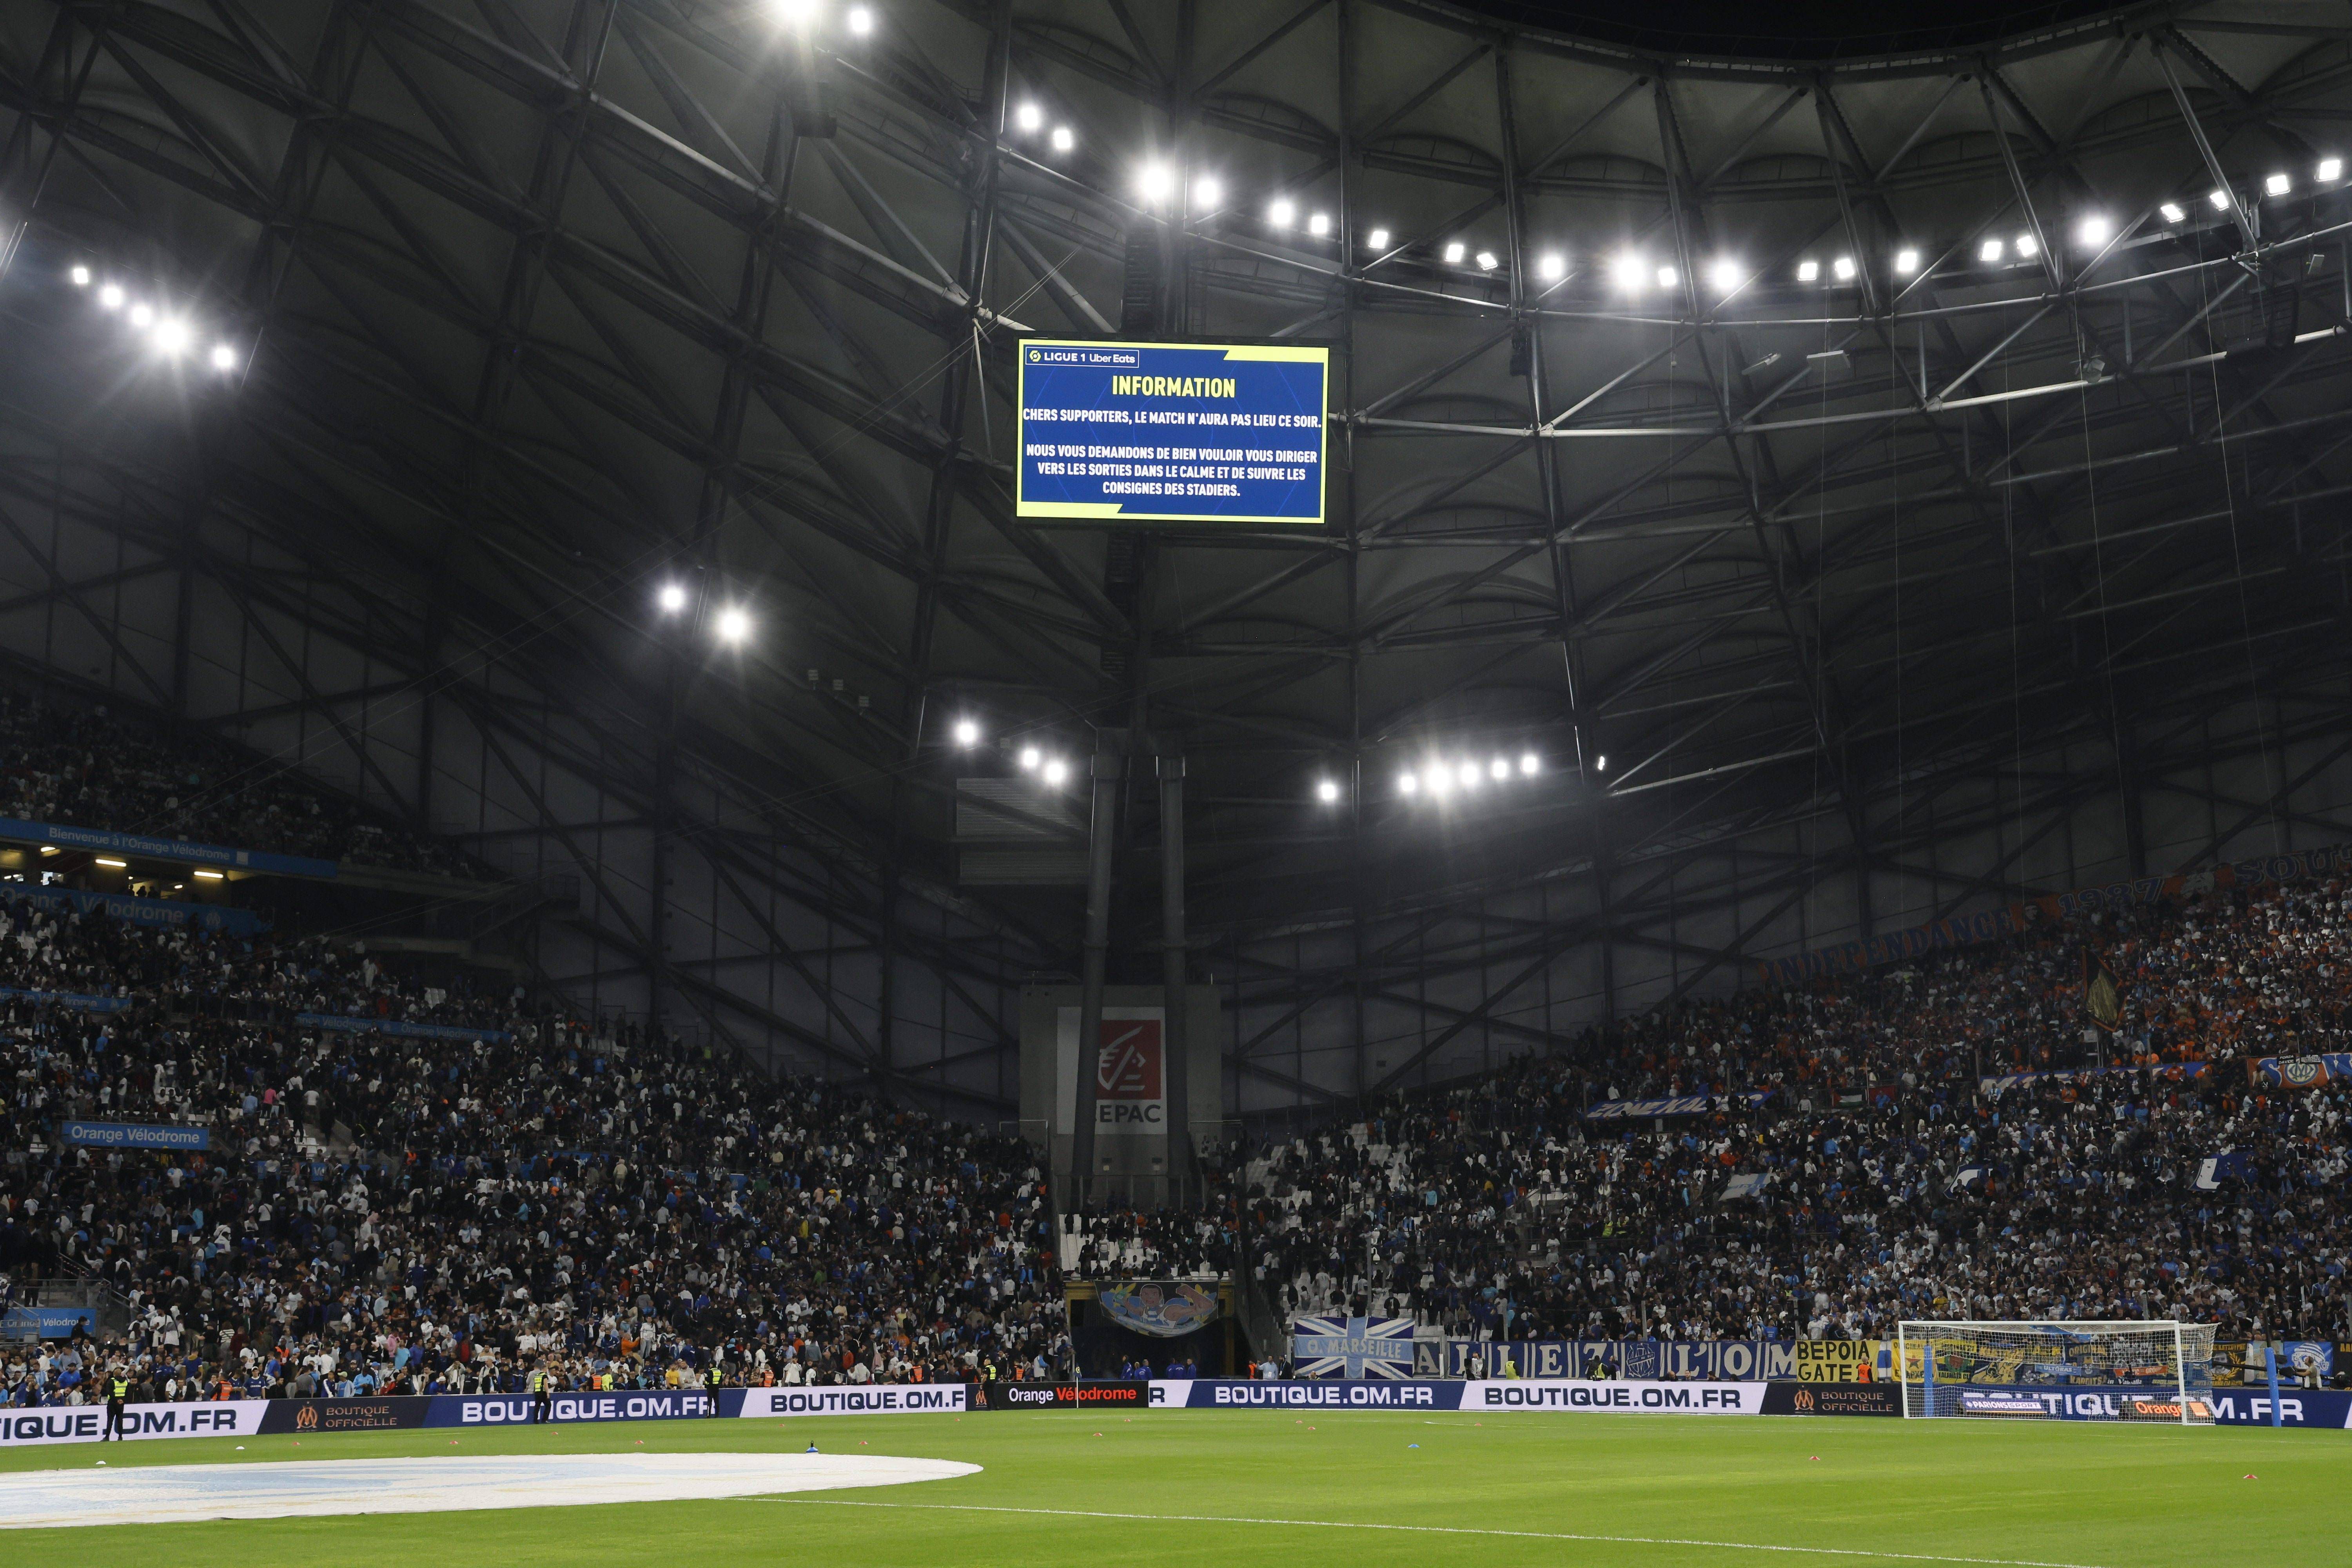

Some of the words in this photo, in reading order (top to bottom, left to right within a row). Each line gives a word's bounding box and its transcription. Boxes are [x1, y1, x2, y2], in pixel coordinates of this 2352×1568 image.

[1044, 352, 1078, 361] LIGUE
[1080, 353, 1085, 362] 1
[1089, 353, 1111, 363] Uber
[1113, 354, 1135, 363] Eats
[1112, 375, 1235, 398] INFORMATION
[1023, 408, 1058, 421] CHERS
[1060, 410, 1132, 425] SUPPORTERS,
[1135, 412, 1147, 423] LE
[1149, 412, 1185, 424] MATCH
[1187, 413, 1228, 425] N'AURA
[1231, 414, 1251, 426] PAS
[1254, 414, 1276, 426] LIEU
[1278, 415, 1291, 426] CE
[1293, 415, 1321, 428] SOIR.
[1027, 444, 1055, 457] NOUS
[1057, 445, 1086, 457] VOUS
[1089, 446, 1154, 459] DEMANDONS
[1157, 447, 1170, 459] DE
[1172, 448, 1196, 460] BIEN
[1198, 448, 1243, 461] VOULOIR
[1245, 449, 1273, 461] VOUS
[1276, 450, 1317, 463] DIRIGER
[1038, 463, 1065, 475] VERS
[1067, 463, 1086, 475] LES
[1089, 464, 1132, 476] SORTIES
[1134, 465, 1163, 477] DANS
[1165, 466, 1178, 477] LE
[1180, 466, 1214, 478] CALME
[1217, 467, 1229, 478] ET
[1232, 467, 1245, 479] DE
[1247, 468, 1285, 480] SUIVRE
[1287, 468, 1305, 480] LES
[1103, 481, 1162, 494] CONSIGNES
[1165, 483, 1184, 495] DES
[1186, 483, 1240, 496] STADIERS.
[49, 826, 109, 845] Bienvenue
[112, 833, 119, 846] à
[122, 836, 169, 853] l'Orange
[172, 843, 230, 861] Vélodrome
[2058, 876, 2165, 919] 1987
[1096, 1104, 1161, 1123] EPAC
[71, 1125, 123, 1143] Orange
[127, 1128, 200, 1143] Vélodrome
[43, 1317, 91, 1327] Vélodroe
[1307, 1339, 1323, 1353] O.
[1328, 1337, 1401, 1359] MARSEILLE
[1676, 1342, 1796, 1377] L'OM
[1798, 1363, 1852, 1382] GATE
[771, 1390, 964, 1412] BOUTIQUE.OM.F
[1009, 1388, 1054, 1404] Orange
[1056, 1387, 1136, 1401] Vélodrome
[1215, 1387, 1433, 1404] BOUTIQUE.OM.FR
[1485, 1388, 1740, 1408] BOUTIQUE.OM.FR
[1822, 1392, 1884, 1402] BOUTIQUE
[326, 1406, 390, 1417] BOUTIQUE
[1822, 1402, 1894, 1412] OFFICIELLE
[1972, 1401, 2009, 1409] PARIONS
[326, 1417, 413, 1428] OFFICIELLE
